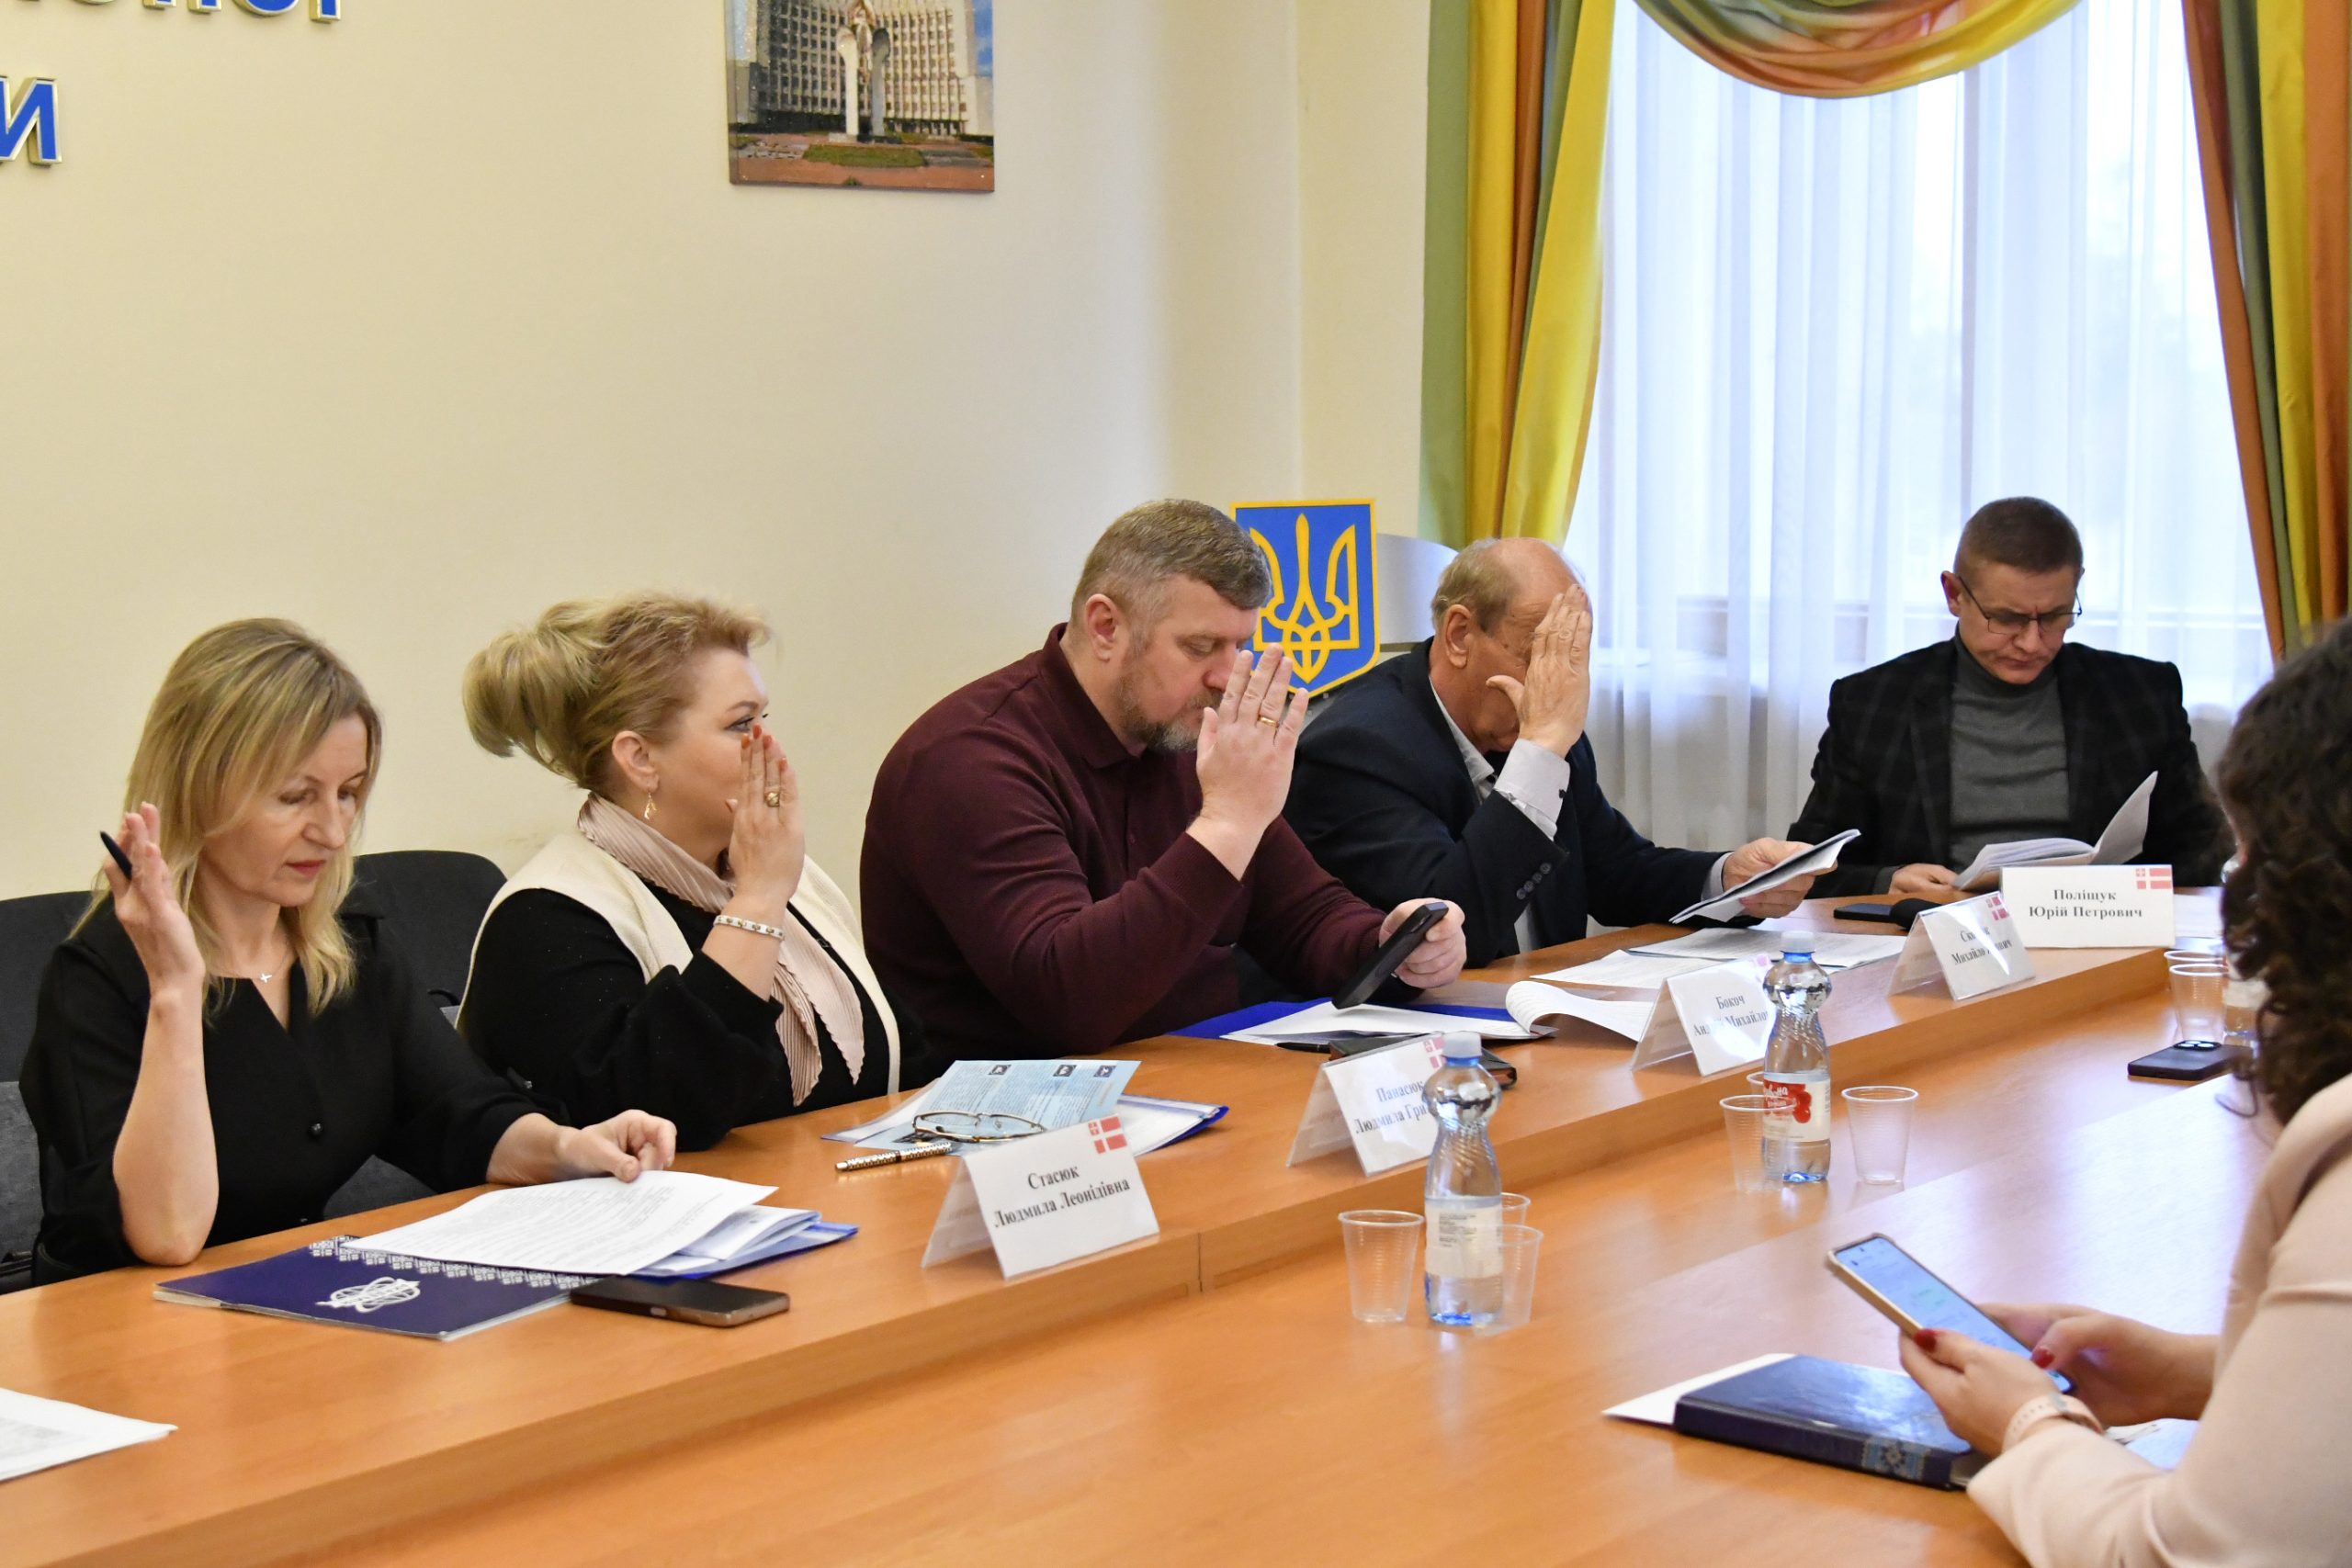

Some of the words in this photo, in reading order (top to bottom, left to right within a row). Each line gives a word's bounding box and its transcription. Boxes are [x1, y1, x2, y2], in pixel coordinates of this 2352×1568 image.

[2053, 889, 2117, 903] Поліщук
[2029, 906, 2068, 920] Юрій
[2073, 906, 2143, 920] Петрович
[1951, 948, 1986, 965] Михайло
[1714, 995, 1746, 1010] Бокоч
[1375, 1080, 1424, 1102] Панасюк
[1354, 1111, 1405, 1134] Людмила
[1027, 1166, 1080, 1190] Стасюк
[994, 1199, 1057, 1228] Людмила
[1059, 1179, 1131, 1210] Леонідівна
